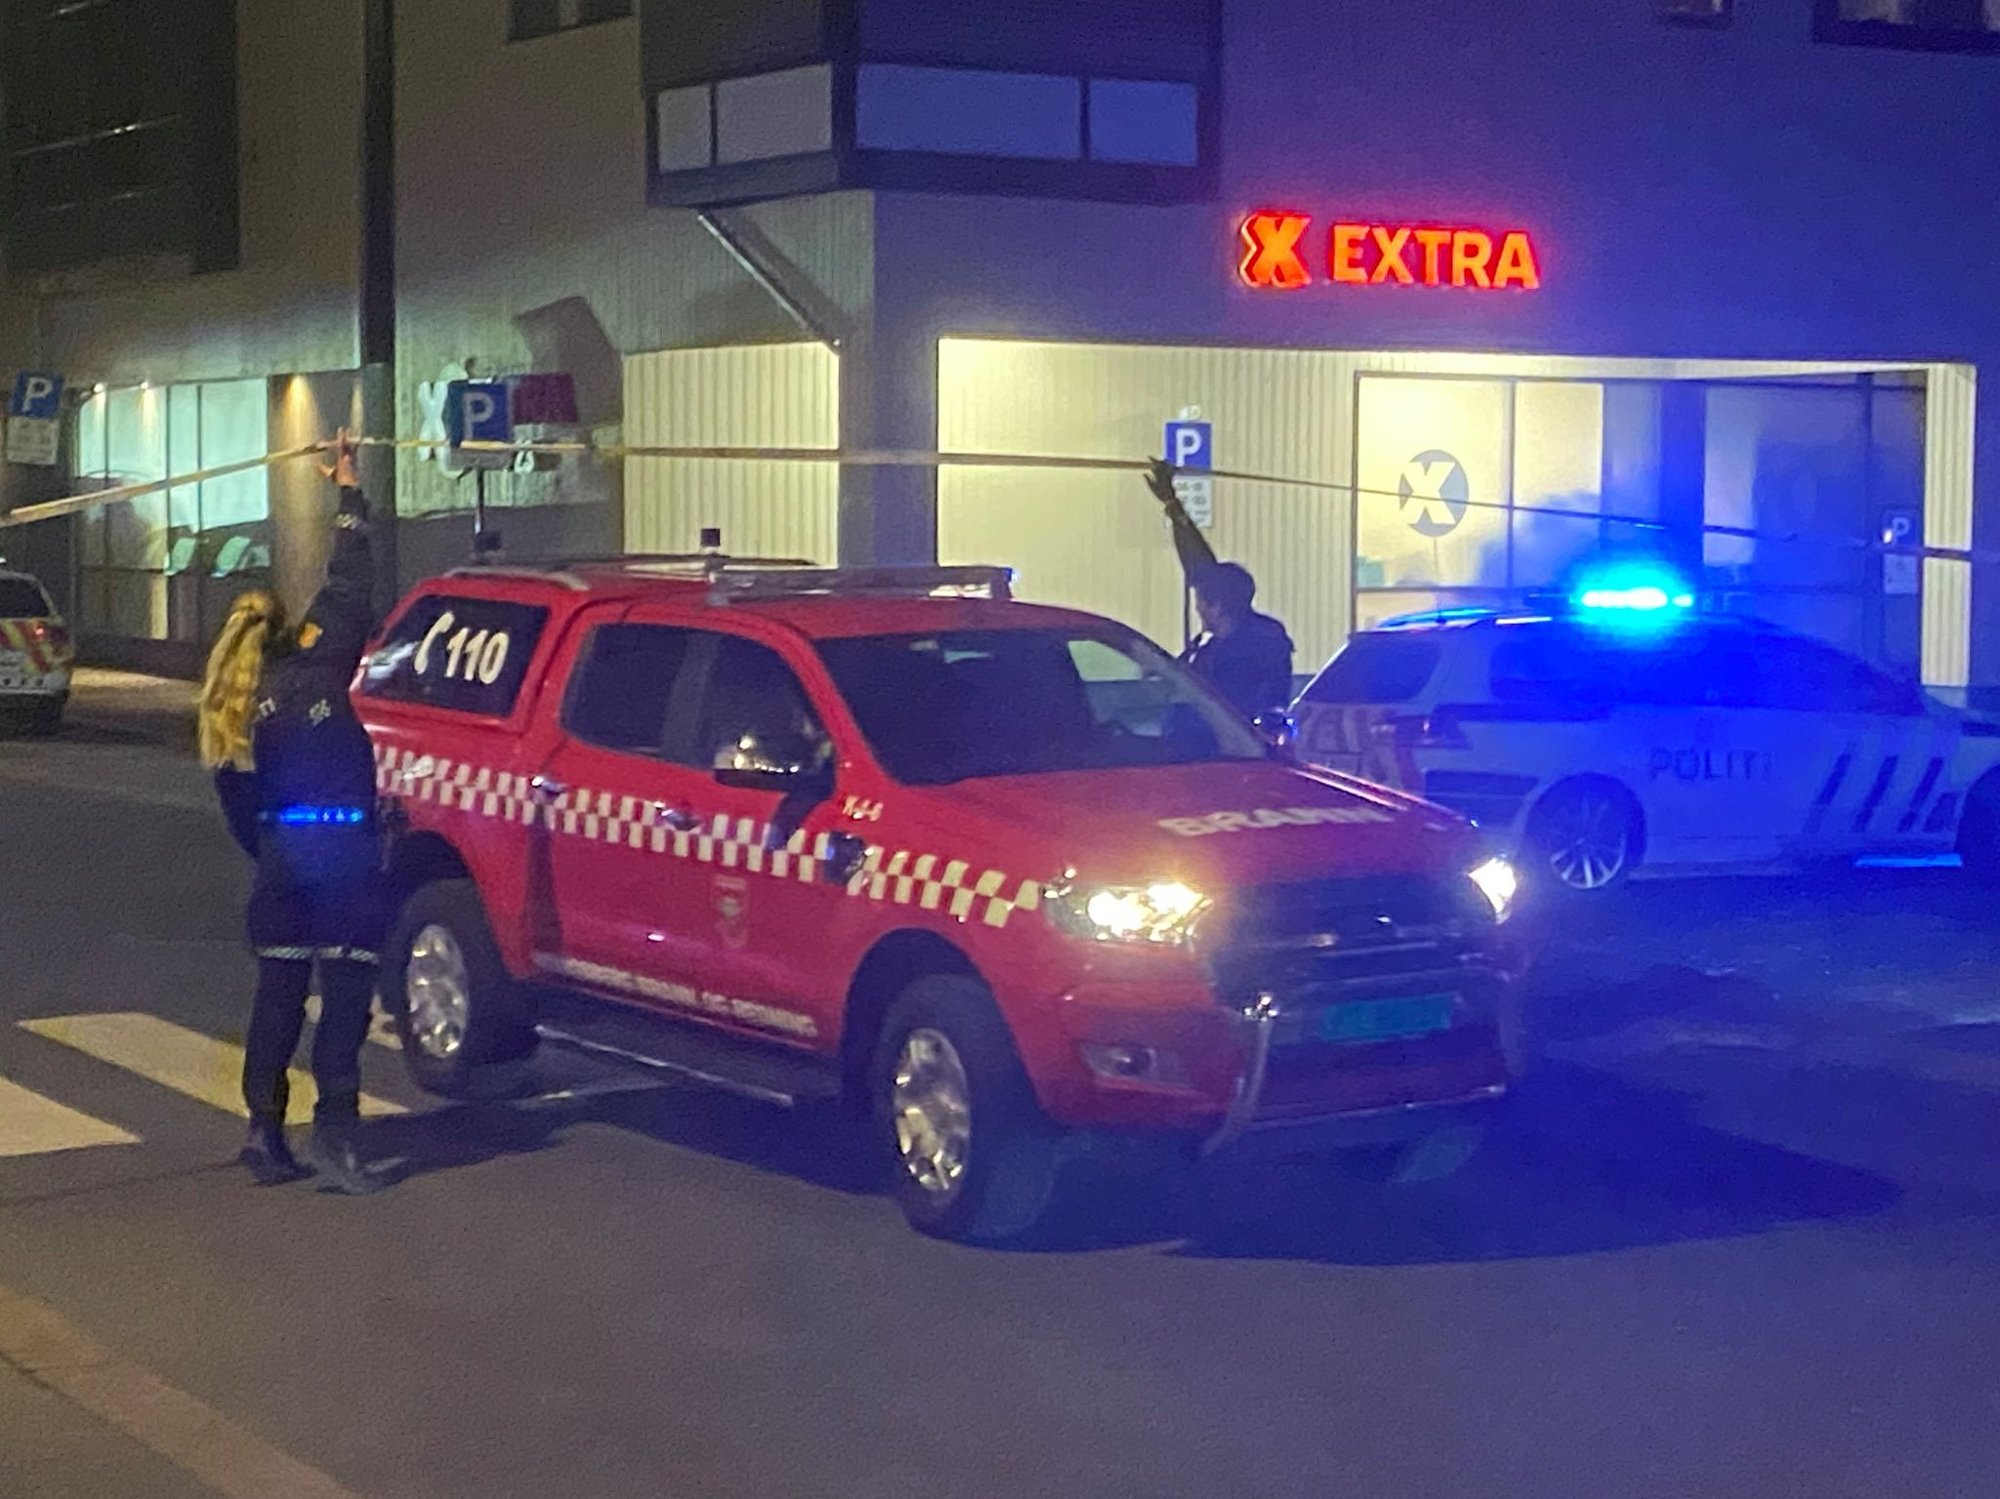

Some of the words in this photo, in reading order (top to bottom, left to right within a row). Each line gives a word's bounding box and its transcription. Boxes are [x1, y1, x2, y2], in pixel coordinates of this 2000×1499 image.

[1332, 222, 1541, 290] EXTRA
[22, 377, 53, 412] P
[463, 392, 495, 441] P
[1175, 427, 1202, 468] P
[1892, 516, 1910, 546] P
[444, 627, 510, 684] 110
[1157, 807, 1396, 837] BRANN
